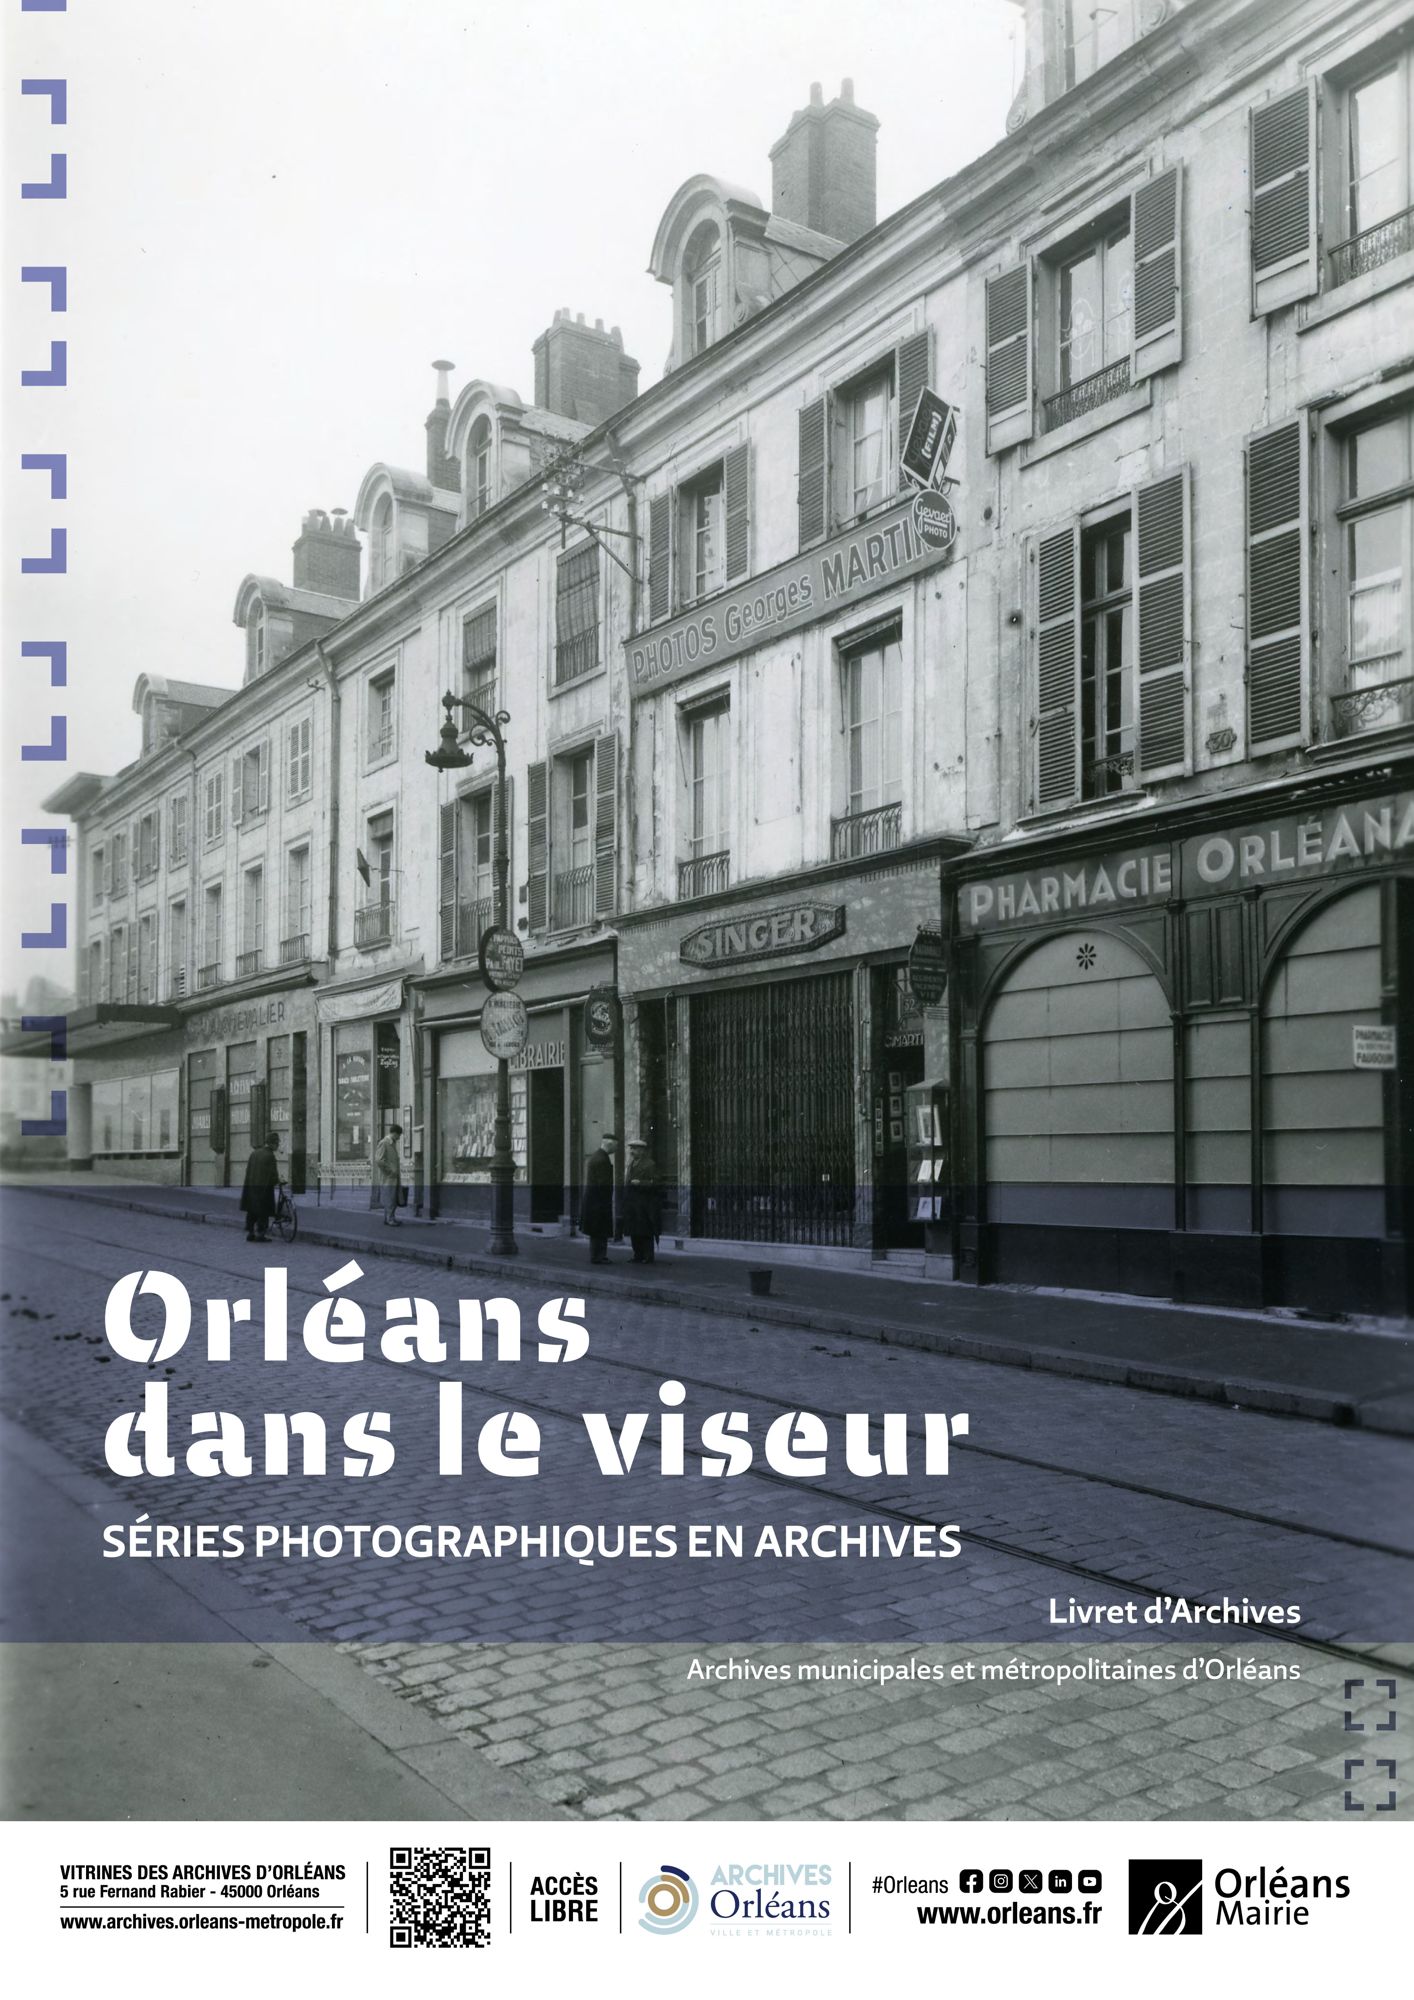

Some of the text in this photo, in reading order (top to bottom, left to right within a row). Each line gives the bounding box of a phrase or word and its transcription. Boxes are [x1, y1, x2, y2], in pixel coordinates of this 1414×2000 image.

[915, 498, 953, 540] Gevaert
[924, 524, 948, 539] PHOTO
[632, 615, 718, 685] PHOTOS
[724, 574, 813, 644] Georges
[970, 852, 1173, 926] PHARMACIE
[697, 909, 816, 960] SINGER
